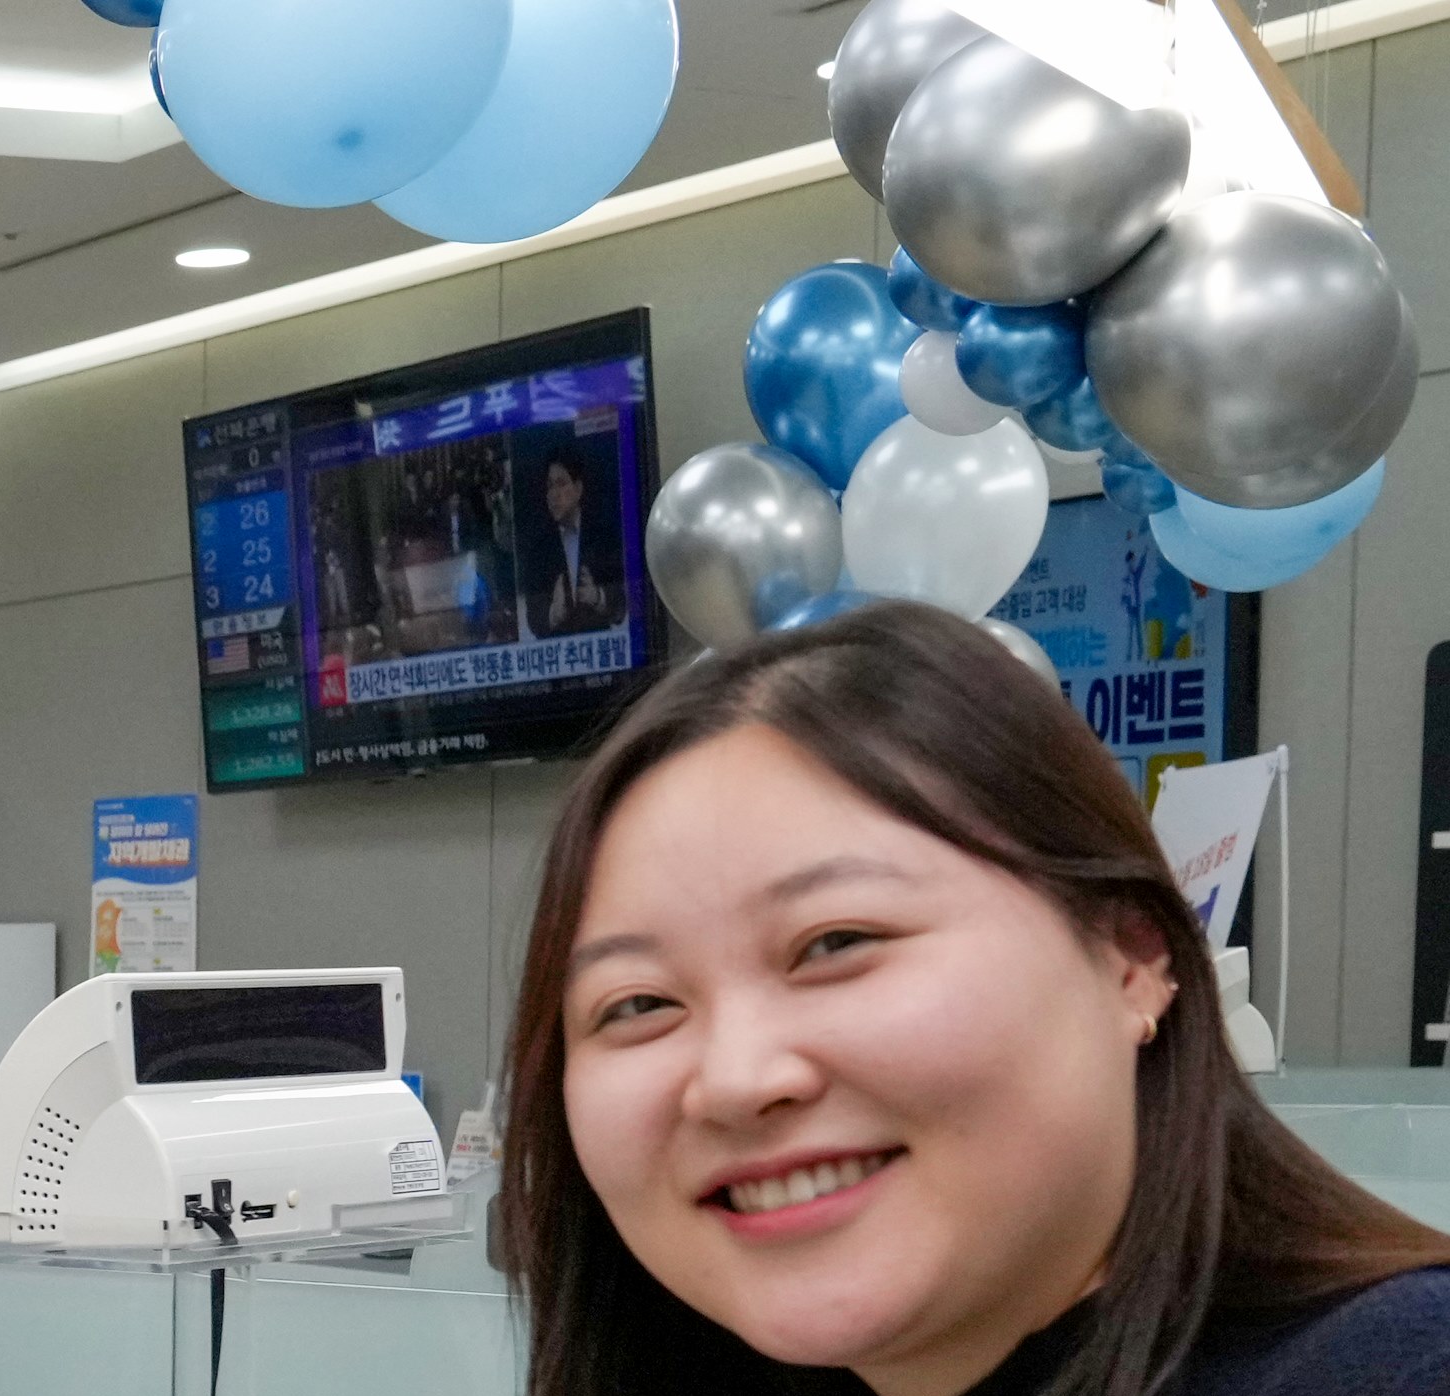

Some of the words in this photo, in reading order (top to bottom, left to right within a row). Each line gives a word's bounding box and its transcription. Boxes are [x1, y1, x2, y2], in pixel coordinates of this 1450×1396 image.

[239, 498, 270, 531] 26
[202, 549, 218, 574] 2
[241, 536, 272, 567] 25
[205, 586, 220, 610] 3
[244, 573, 275, 603] 24
[1085, 668, 1206, 746] 이벤트
